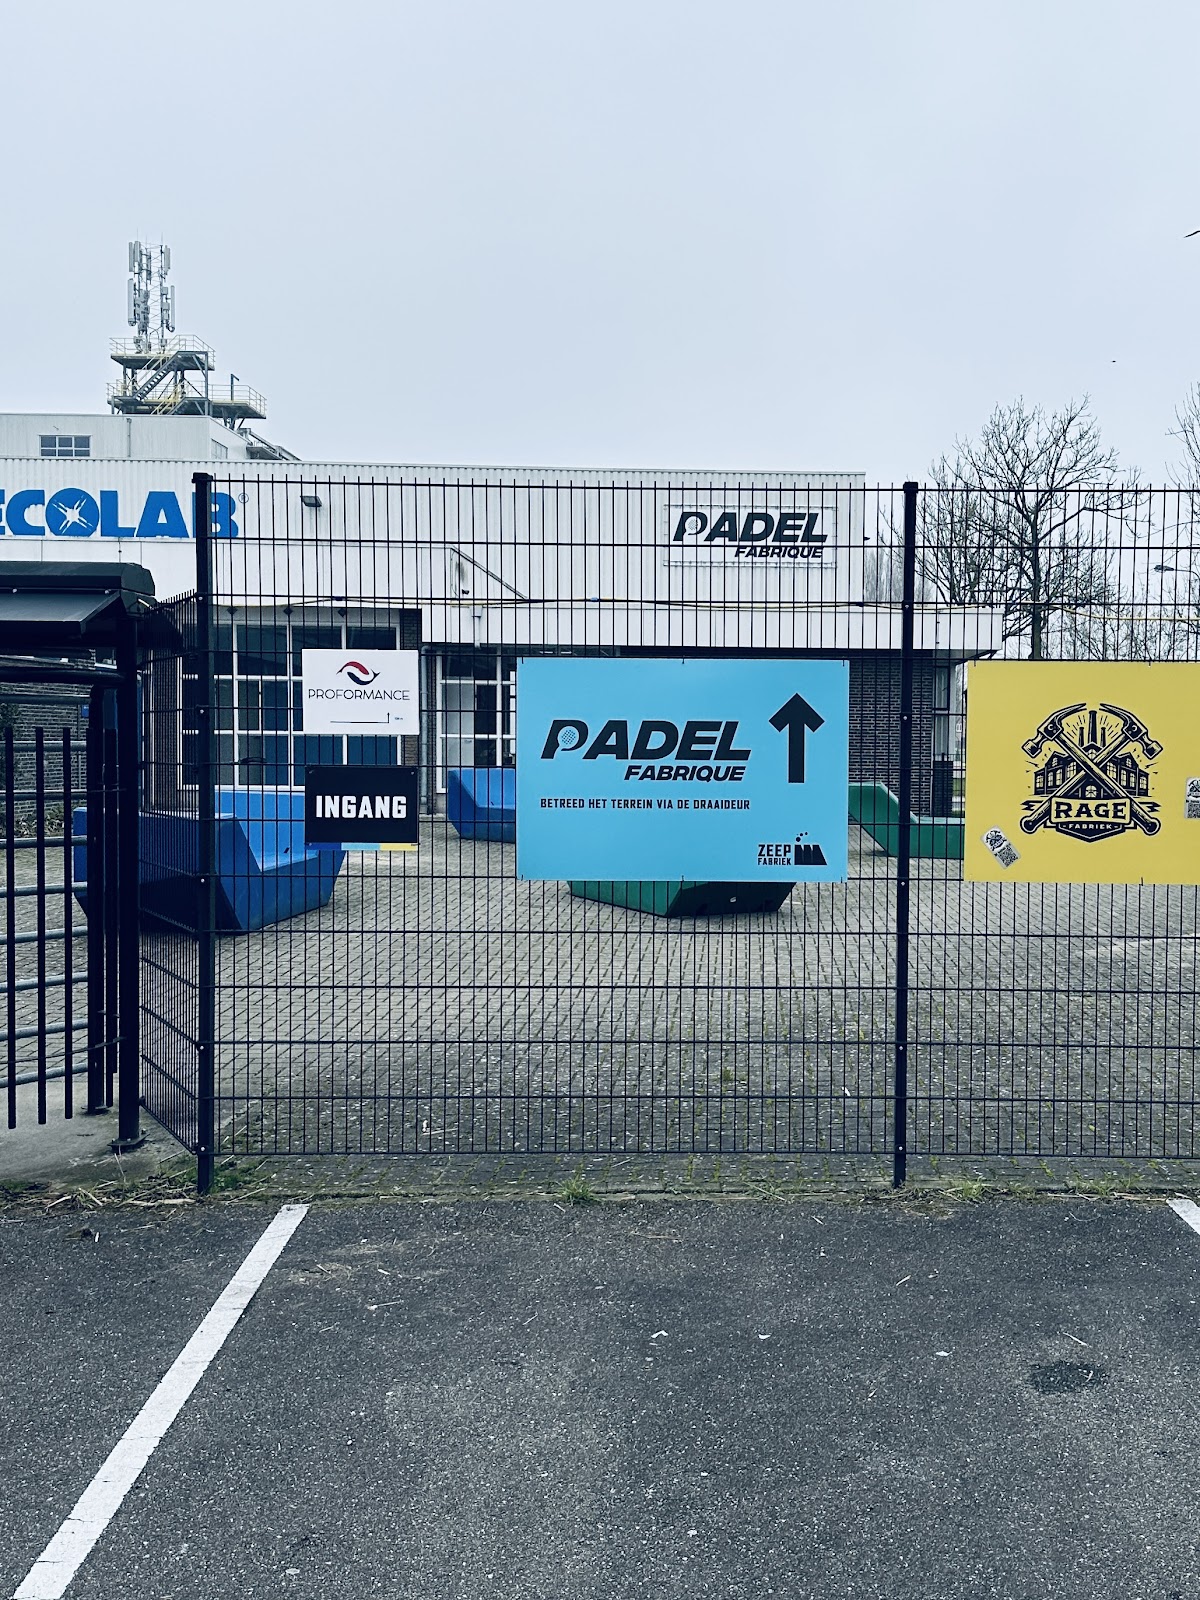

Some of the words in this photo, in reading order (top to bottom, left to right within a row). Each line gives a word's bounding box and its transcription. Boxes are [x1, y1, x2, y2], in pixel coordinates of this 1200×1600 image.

[0, 487, 239, 538] COLAB
[673, 511, 828, 543] PADEL
[734, 546, 824, 559] FABRIQUE
[308, 688, 411, 701] PROFORMANCE
[540, 719, 751, 761] PADEL
[624, 765, 746, 783] FABRIQUE
[315, 795, 407, 819] INGANG
[540, 798, 585, 809] BETREED
[588, 798, 607, 809] HET
[611, 799, 653, 809] TERREIN
[656, 799, 673, 809] VIA
[677, 799, 690, 809] DE
[693, 799, 750, 810] DRAAIDEUR
[1054, 801, 1127, 820] RAGE
[757, 844, 791, 857] ZEEP
[757, 857, 791, 866] FABRIEK
